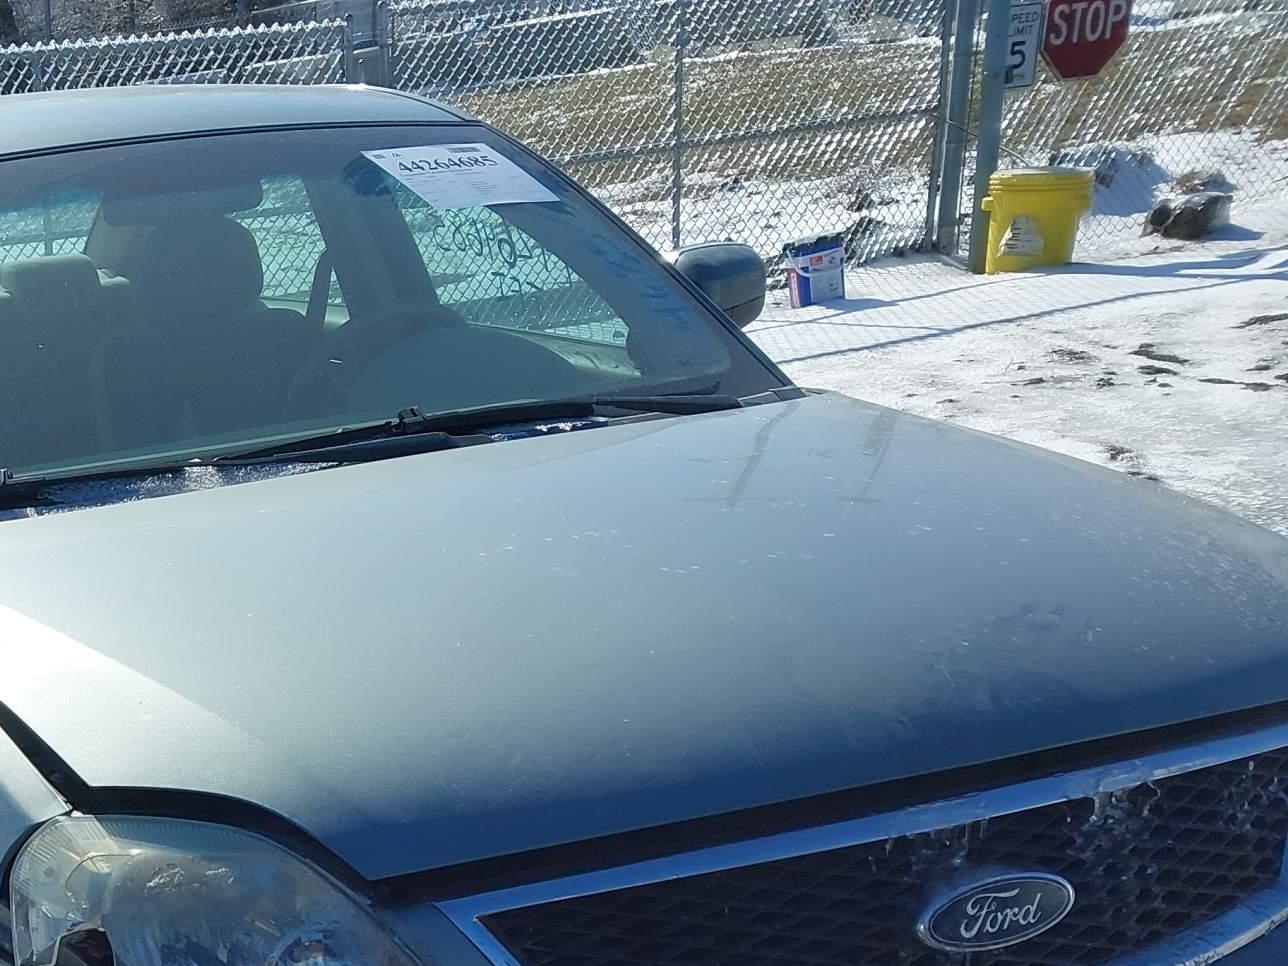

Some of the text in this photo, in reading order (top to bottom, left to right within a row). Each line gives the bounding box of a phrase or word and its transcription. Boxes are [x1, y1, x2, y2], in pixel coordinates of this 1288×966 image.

[1011, 11, 1039, 24] PEED
[1050, 0, 1128, 46] STOP
[398, 155, 499, 173] 44264685
[960, 888, 1042, 939] Ford
